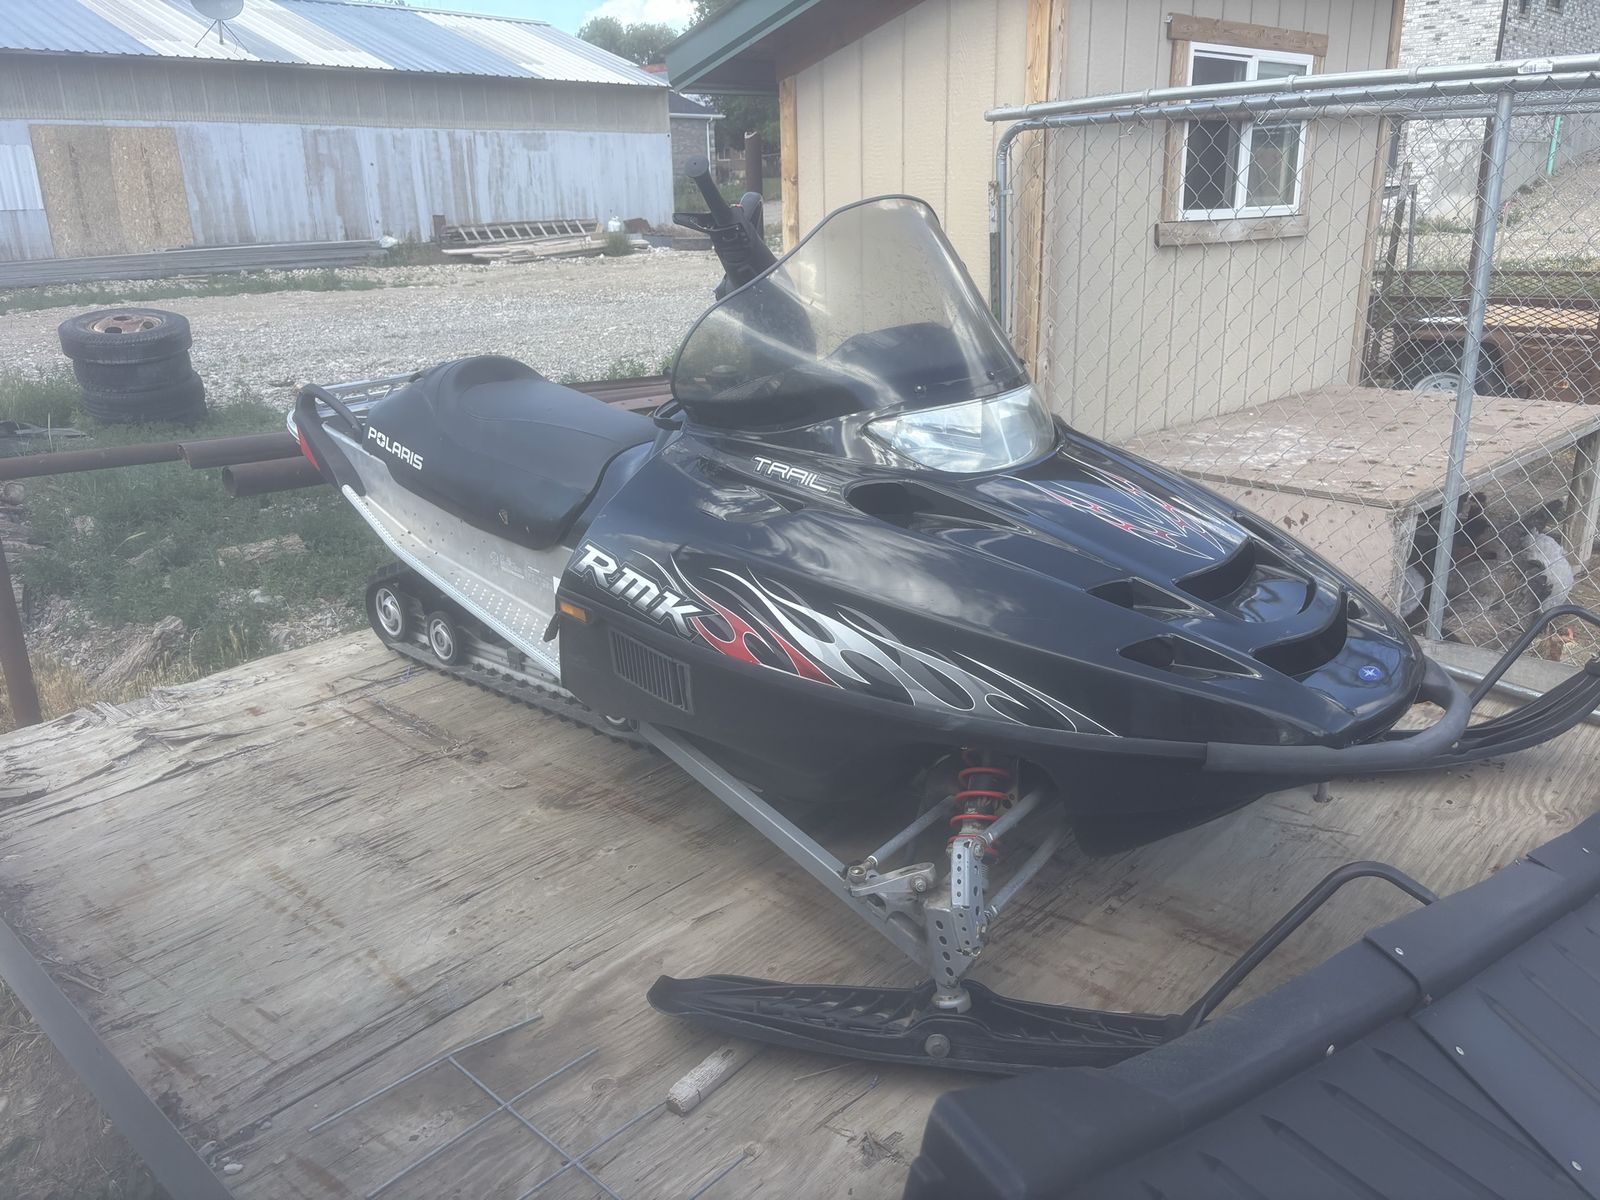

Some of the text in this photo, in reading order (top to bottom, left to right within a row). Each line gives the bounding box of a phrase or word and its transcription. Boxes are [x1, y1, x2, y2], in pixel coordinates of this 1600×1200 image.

[367, 426, 424, 471] POLARIS
[754, 456, 830, 493] TRAIL
[573, 543, 705, 637] RMK
